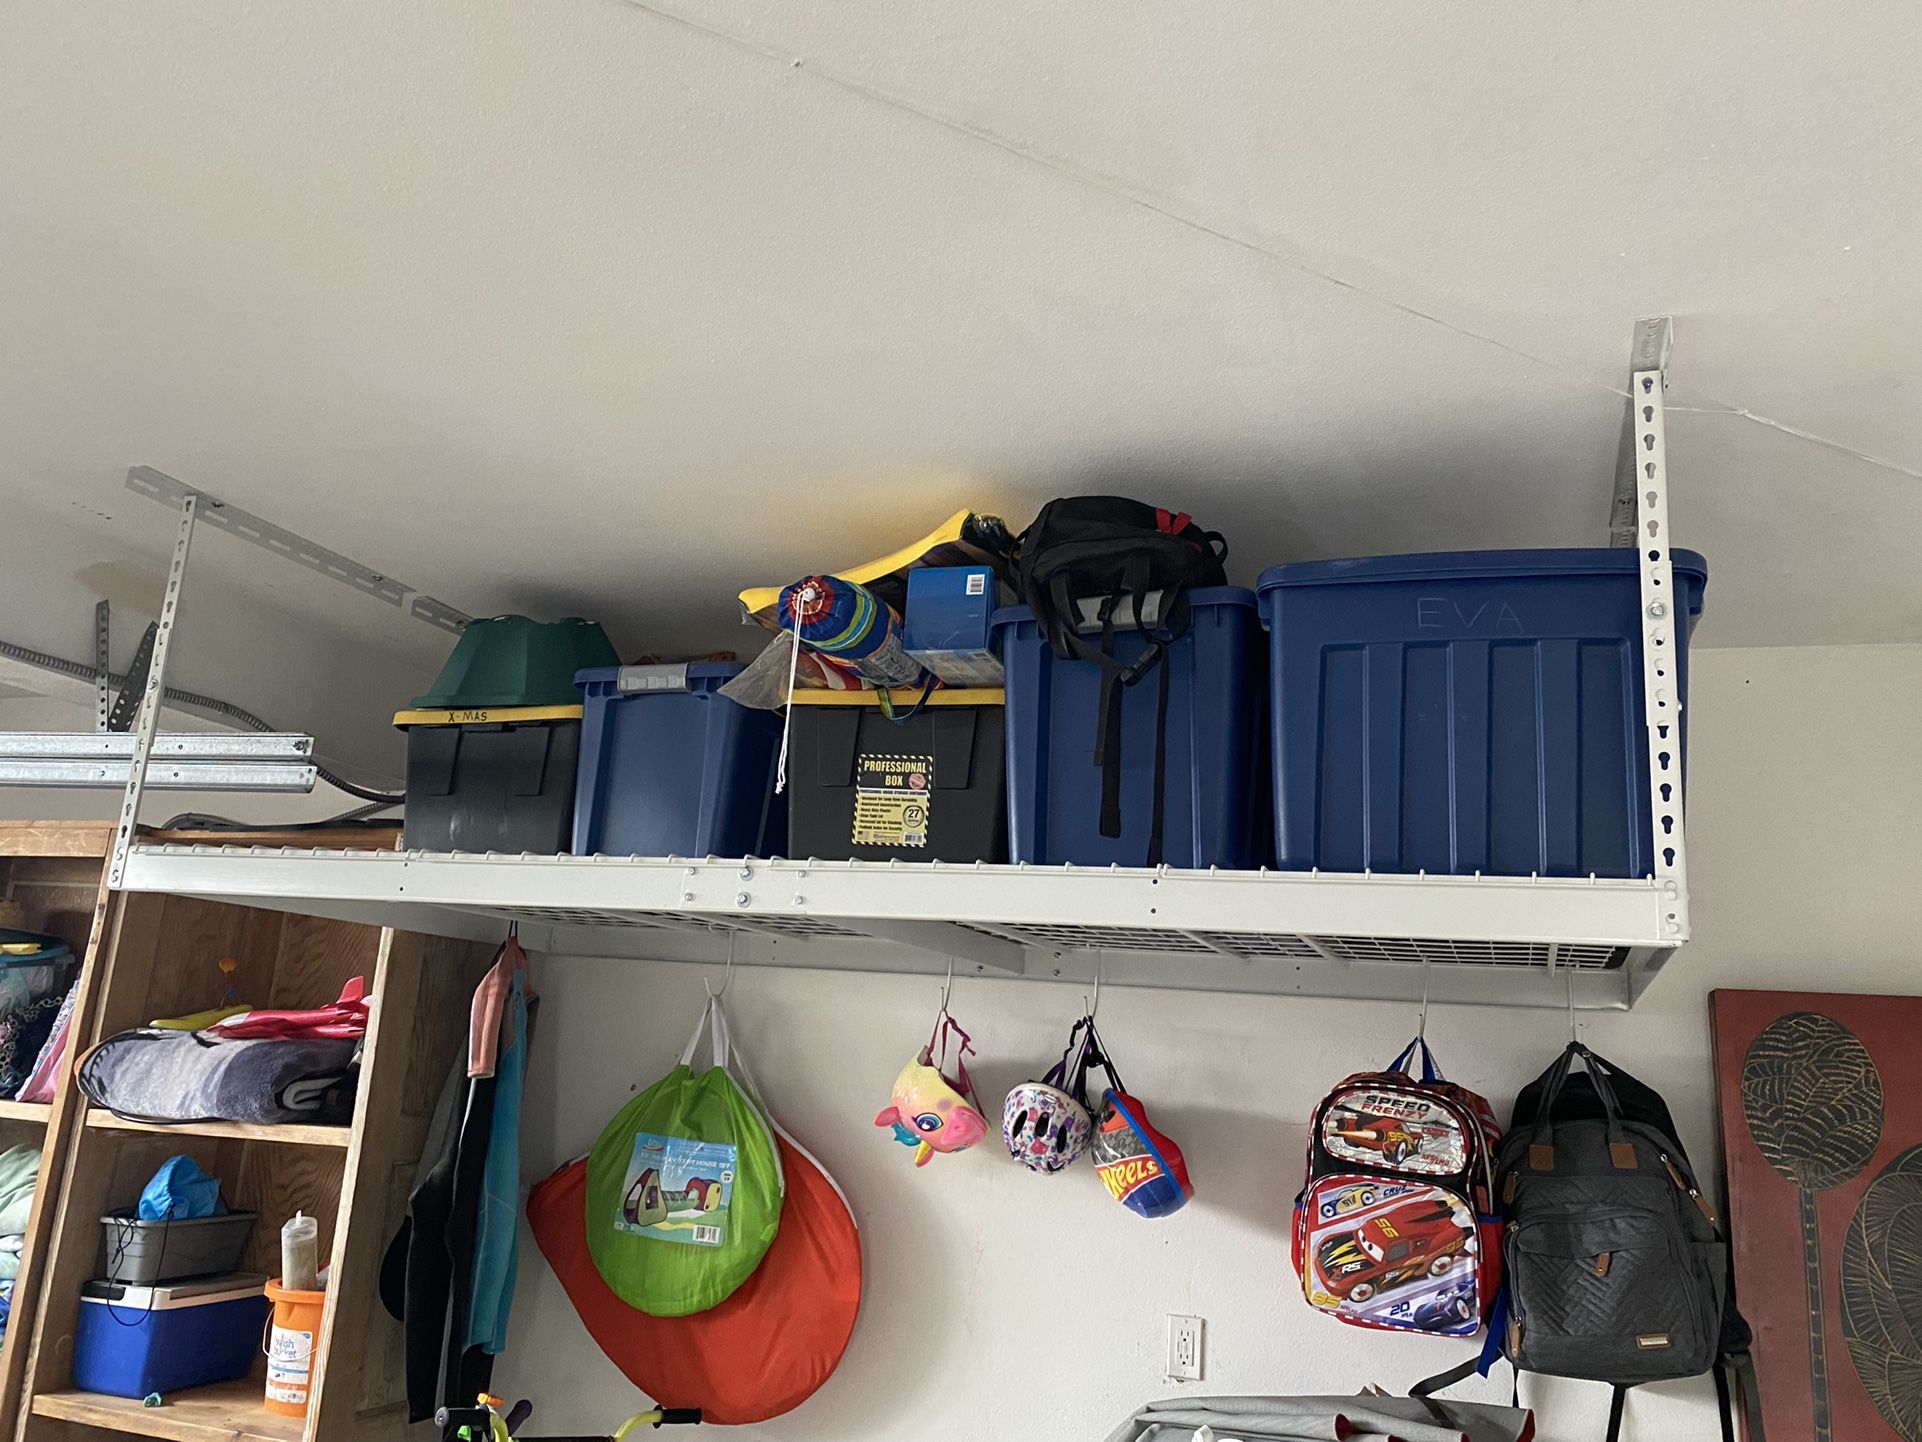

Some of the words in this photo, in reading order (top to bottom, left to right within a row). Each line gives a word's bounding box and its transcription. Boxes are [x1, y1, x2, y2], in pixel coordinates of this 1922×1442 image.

[1417, 597, 1525, 634] EVA
[448, 711, 488, 722] X-MAS
[864, 760, 927, 773] PROFESSIONAL
[885, 774, 903, 786] BOX
[908, 808, 920, 818] 27
[1365, 1095, 1431, 1112] SPEED
[1361, 1103, 1427, 1119] FRENZY
[1390, 1301, 1411, 1316] 20
